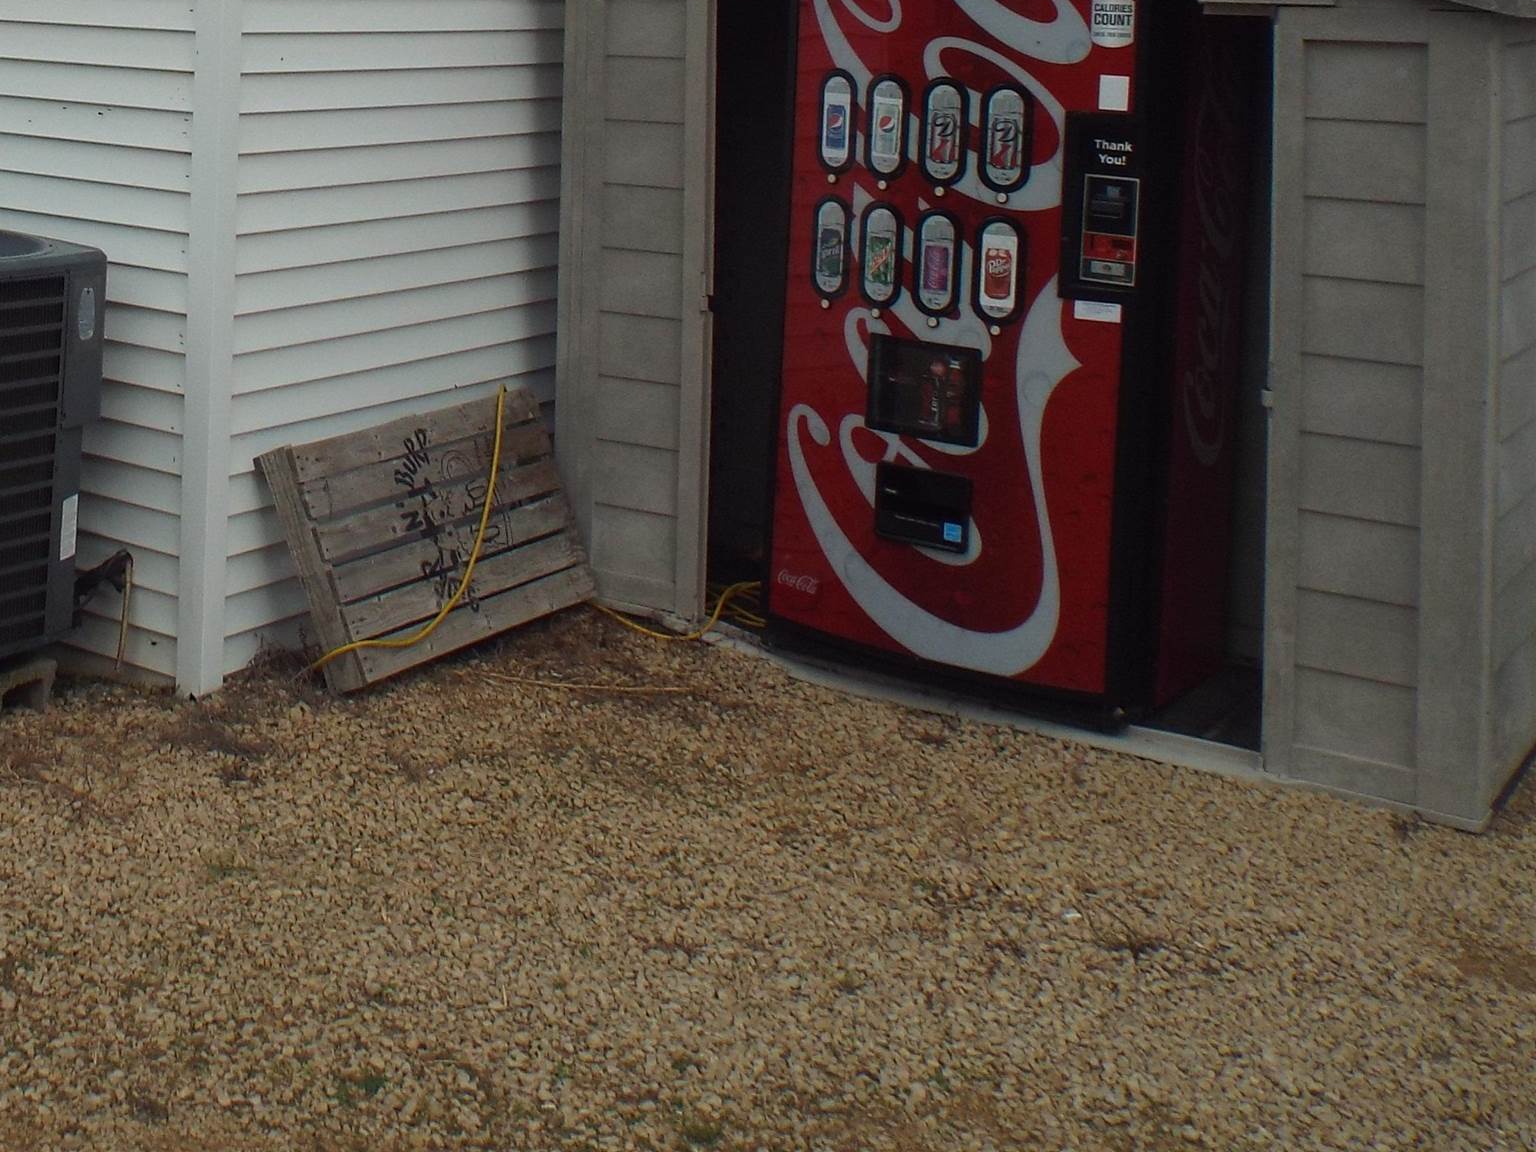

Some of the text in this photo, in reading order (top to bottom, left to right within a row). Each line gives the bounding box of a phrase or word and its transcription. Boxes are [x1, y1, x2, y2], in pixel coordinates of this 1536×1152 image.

[1094, 3, 1133, 13] CALORIES
[1093, 13, 1132, 26] COUNT
[1093, 139, 1133, 152] Thank
[1098, 153, 1127, 166] You!
[777, 568, 820, 596] Coca-Cola
